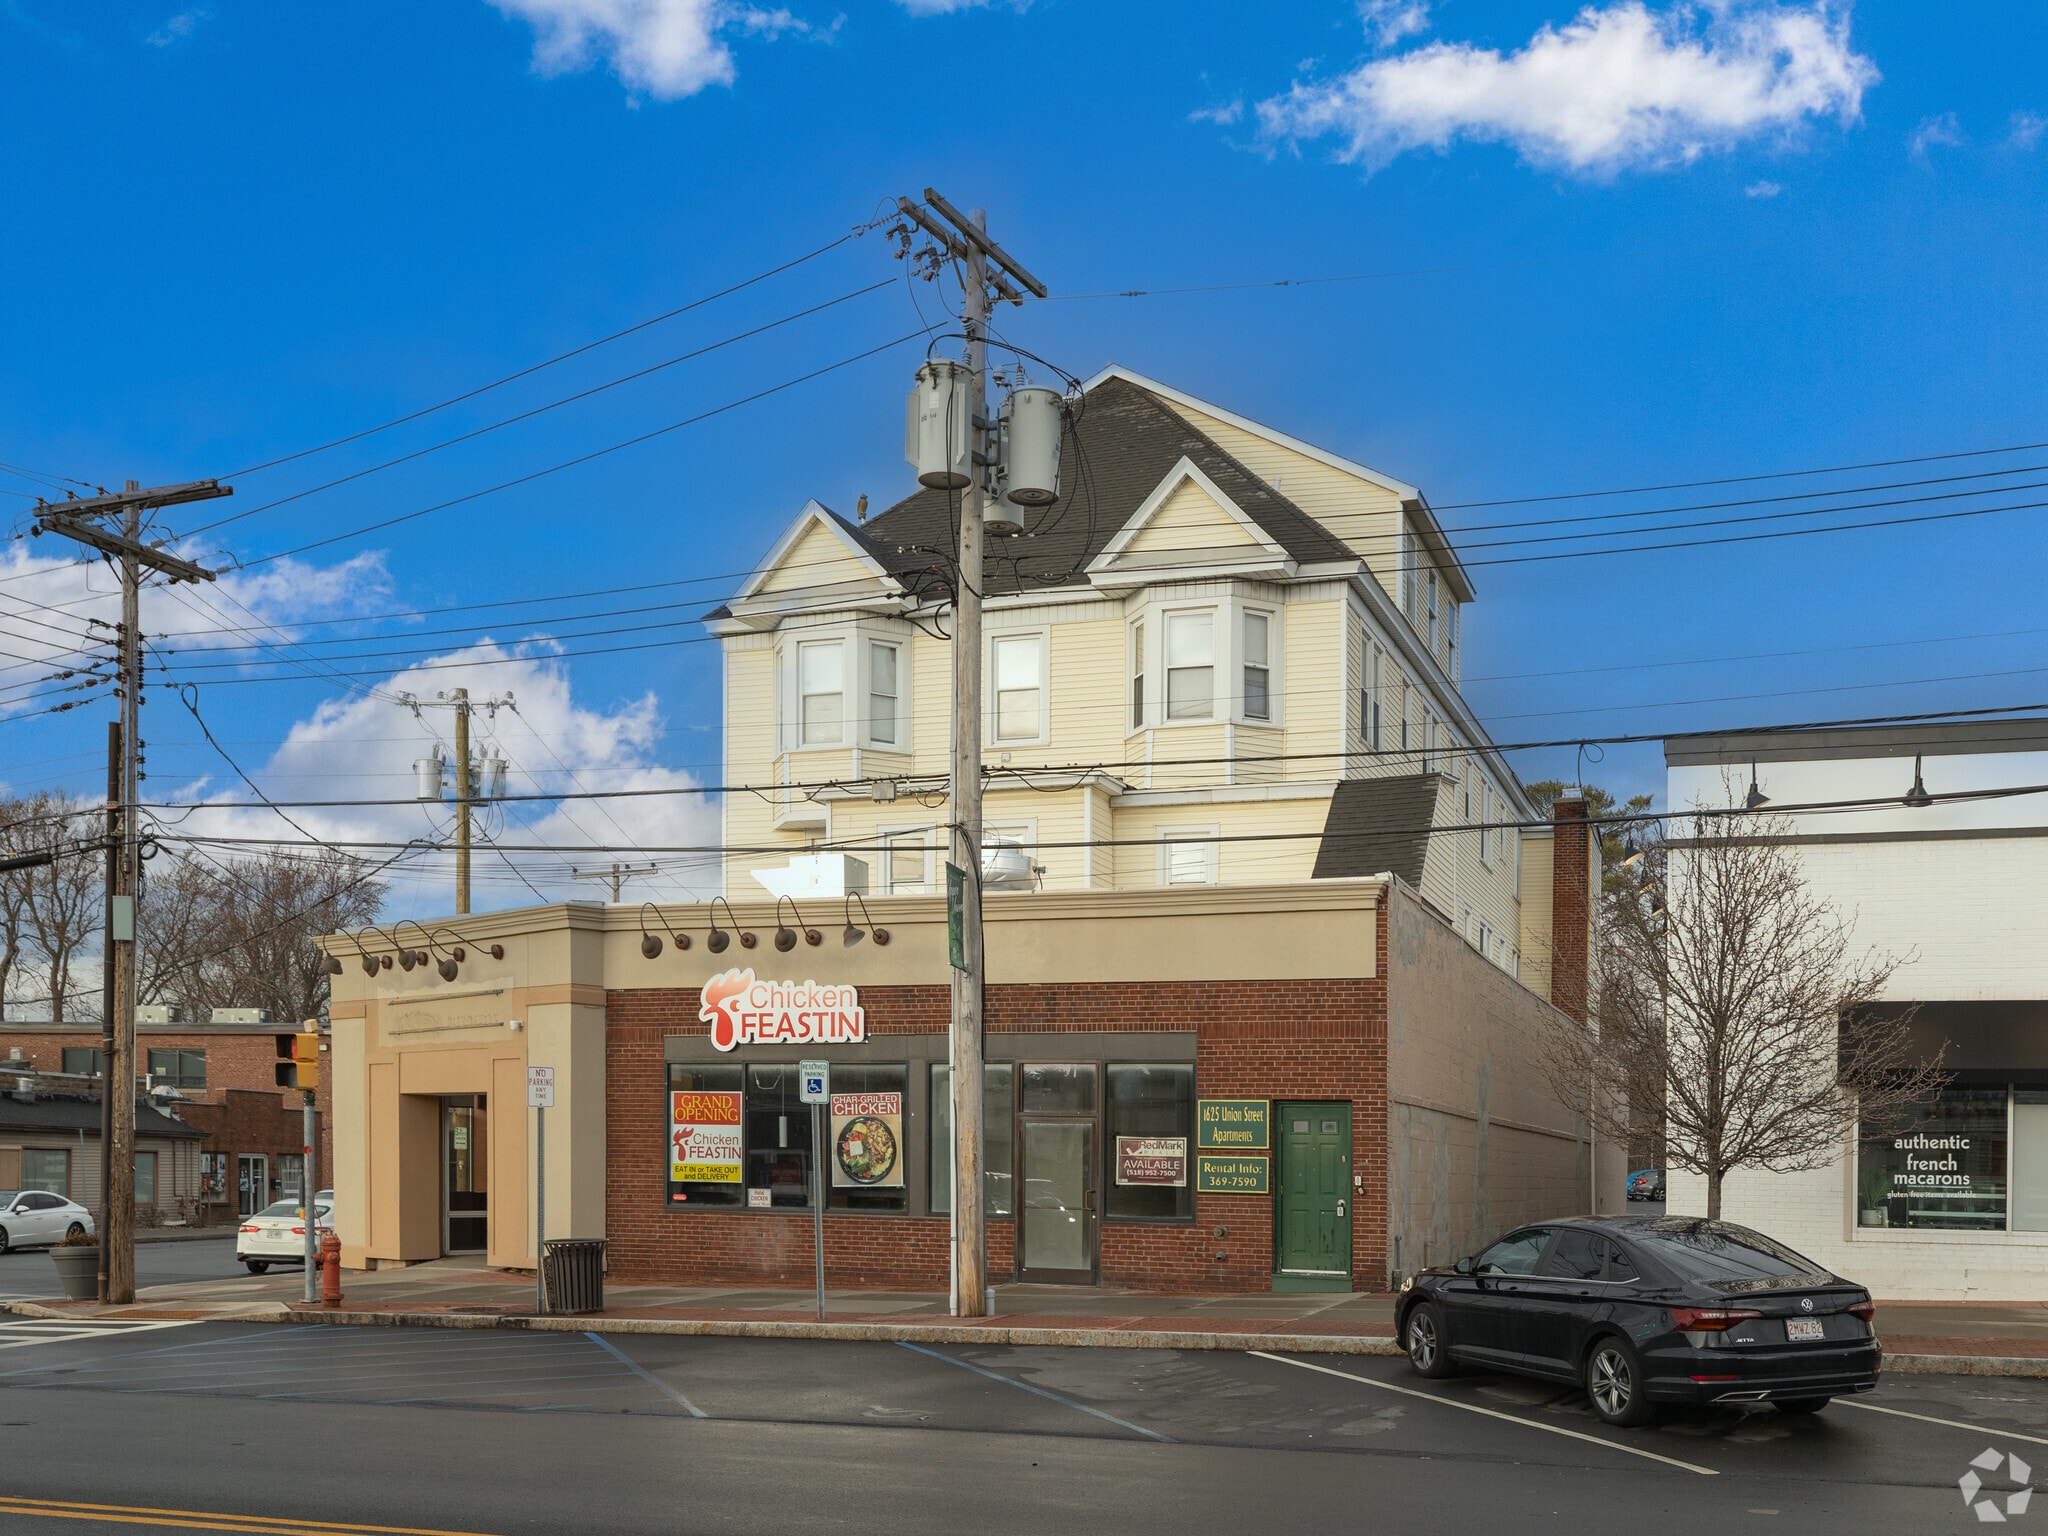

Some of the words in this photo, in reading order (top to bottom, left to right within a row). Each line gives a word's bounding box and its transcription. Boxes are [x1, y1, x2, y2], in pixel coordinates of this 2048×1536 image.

[750, 984, 853, 1009] Chicken
[741, 1012, 860, 1038] FEASTIN
[528, 1078, 553, 1086] PARKING
[681, 1095, 732, 1108] GRAND
[832, 1095, 898, 1104] CHAR-GRILLED
[675, 1108, 738, 1121] OPENING
[834, 1103, 897, 1115] CHICKEN
[1203, 1106, 1219, 1122] 1625
[1221, 1107, 1242, 1121] Union
[1244, 1107, 1264, 1122] Street
[693, 1133, 739, 1145] Chicken
[1212, 1126, 1253, 1144] Apartments
[1140, 1140, 1183, 1149] RedMark
[1894, 1133, 1970, 1150] authentic
[689, 1146, 742, 1159] FEASTIN
[1123, 1160, 1180, 1170] AVAILABLE
[1204, 1162, 1236, 1173] Rental
[1239, 1163, 1262, 1174] Info:
[1907, 1153, 1958, 1171] french
[1209, 1177, 1257, 1187] 369-7590
[1894, 1174, 1970, 1185] macarons
[1886, 1190, 1909, 1199] gluten
[1909, 1190, 1924, 1198] free
[1925, 1190, 1944, 1198] items
[1946, 1190, 1977, 1198] available
